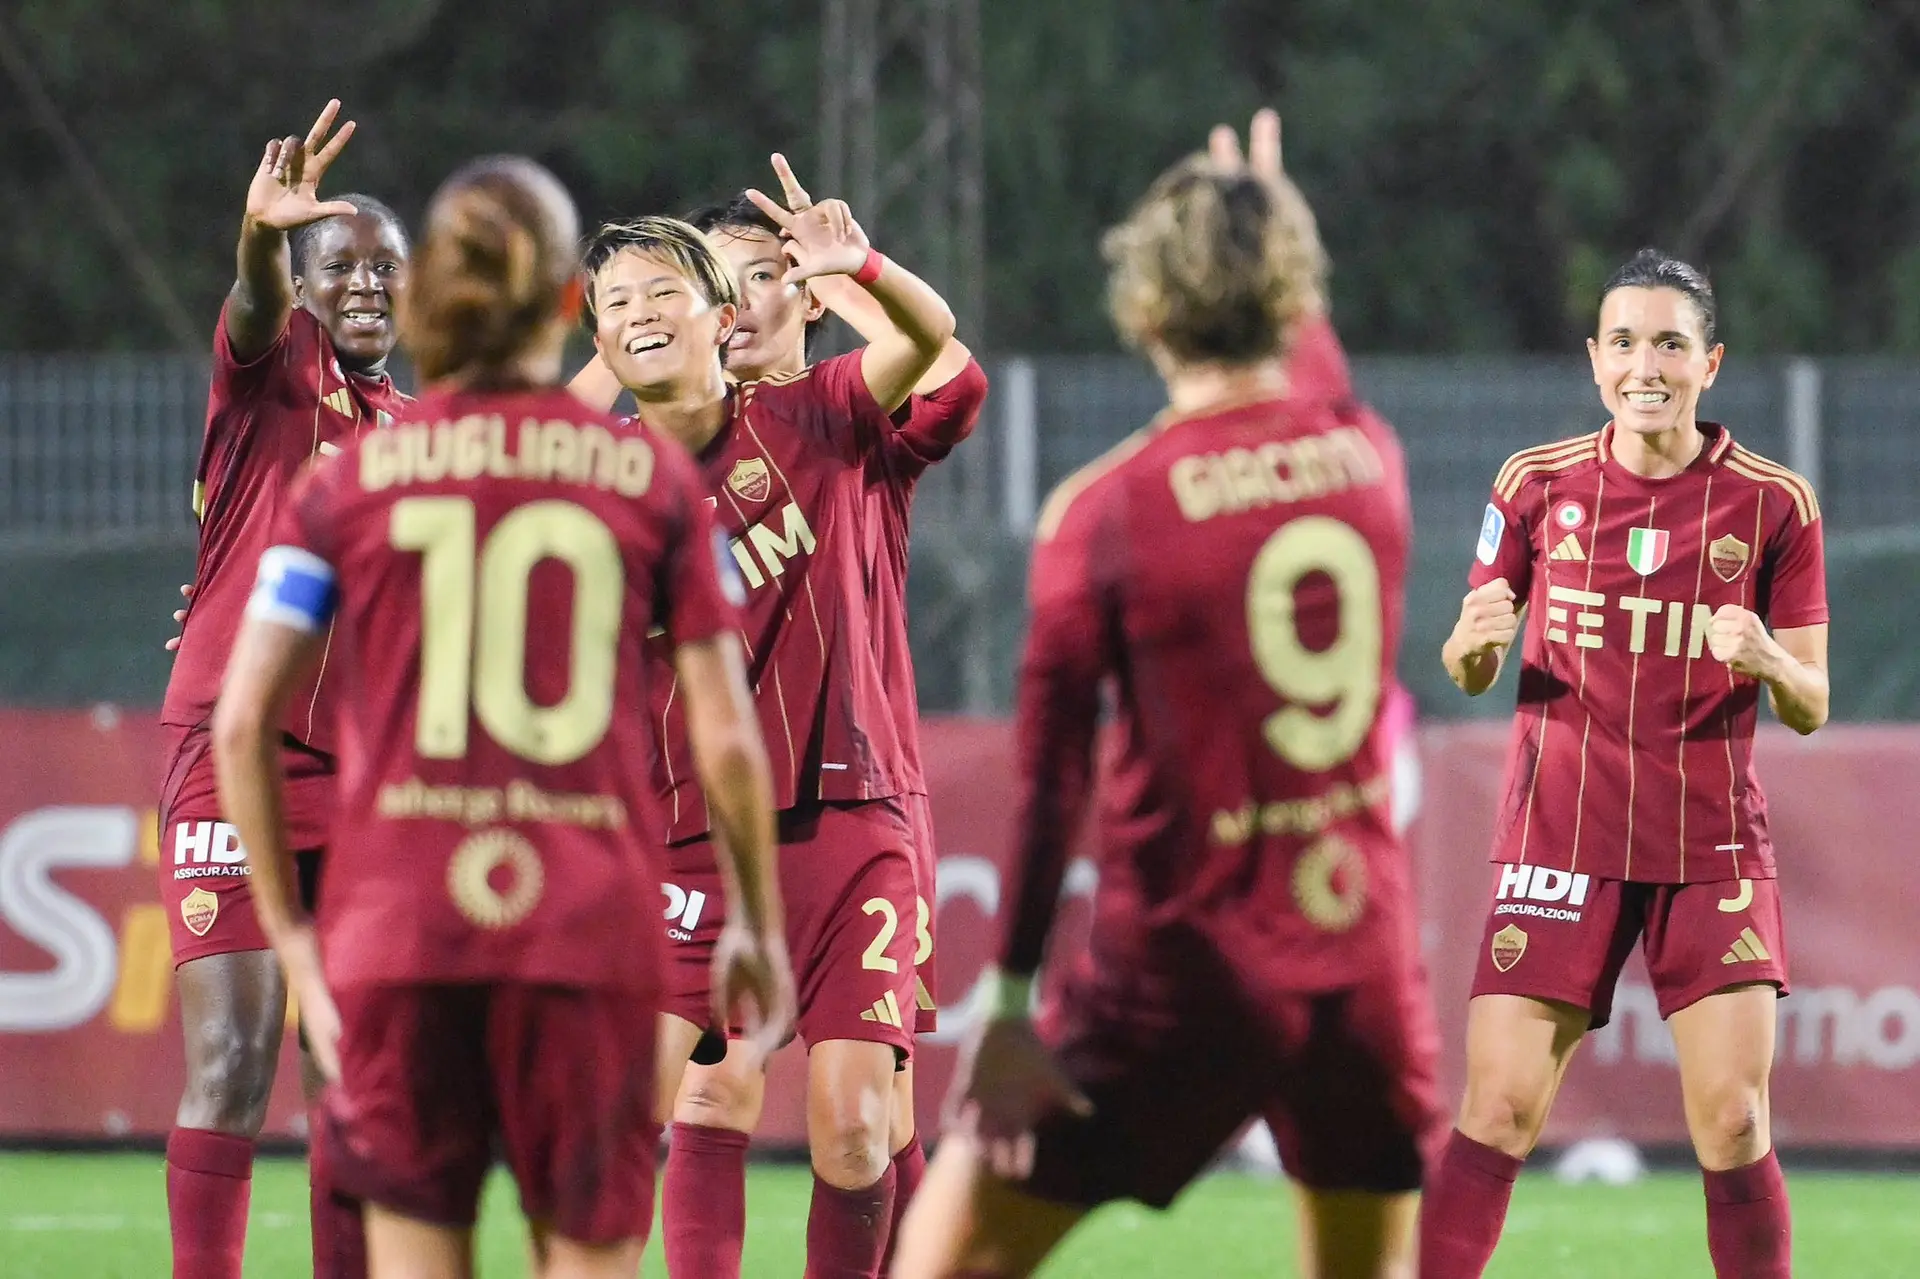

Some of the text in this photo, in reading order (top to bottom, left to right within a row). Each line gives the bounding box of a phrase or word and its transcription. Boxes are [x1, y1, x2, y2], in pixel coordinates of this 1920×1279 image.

[360, 413, 655, 498] GIUGLIANO
[730, 501, 817, 590] IM
[391, 496, 625, 765] 10
[1245, 514, 1383, 772] 9
[174, 821, 249, 865] HD
[174, 865, 253, 880] ASSICURAZIO
[661, 882, 706, 932] DI
[1495, 862, 1590, 906] HDI
[861, 896, 898, 974] 2
